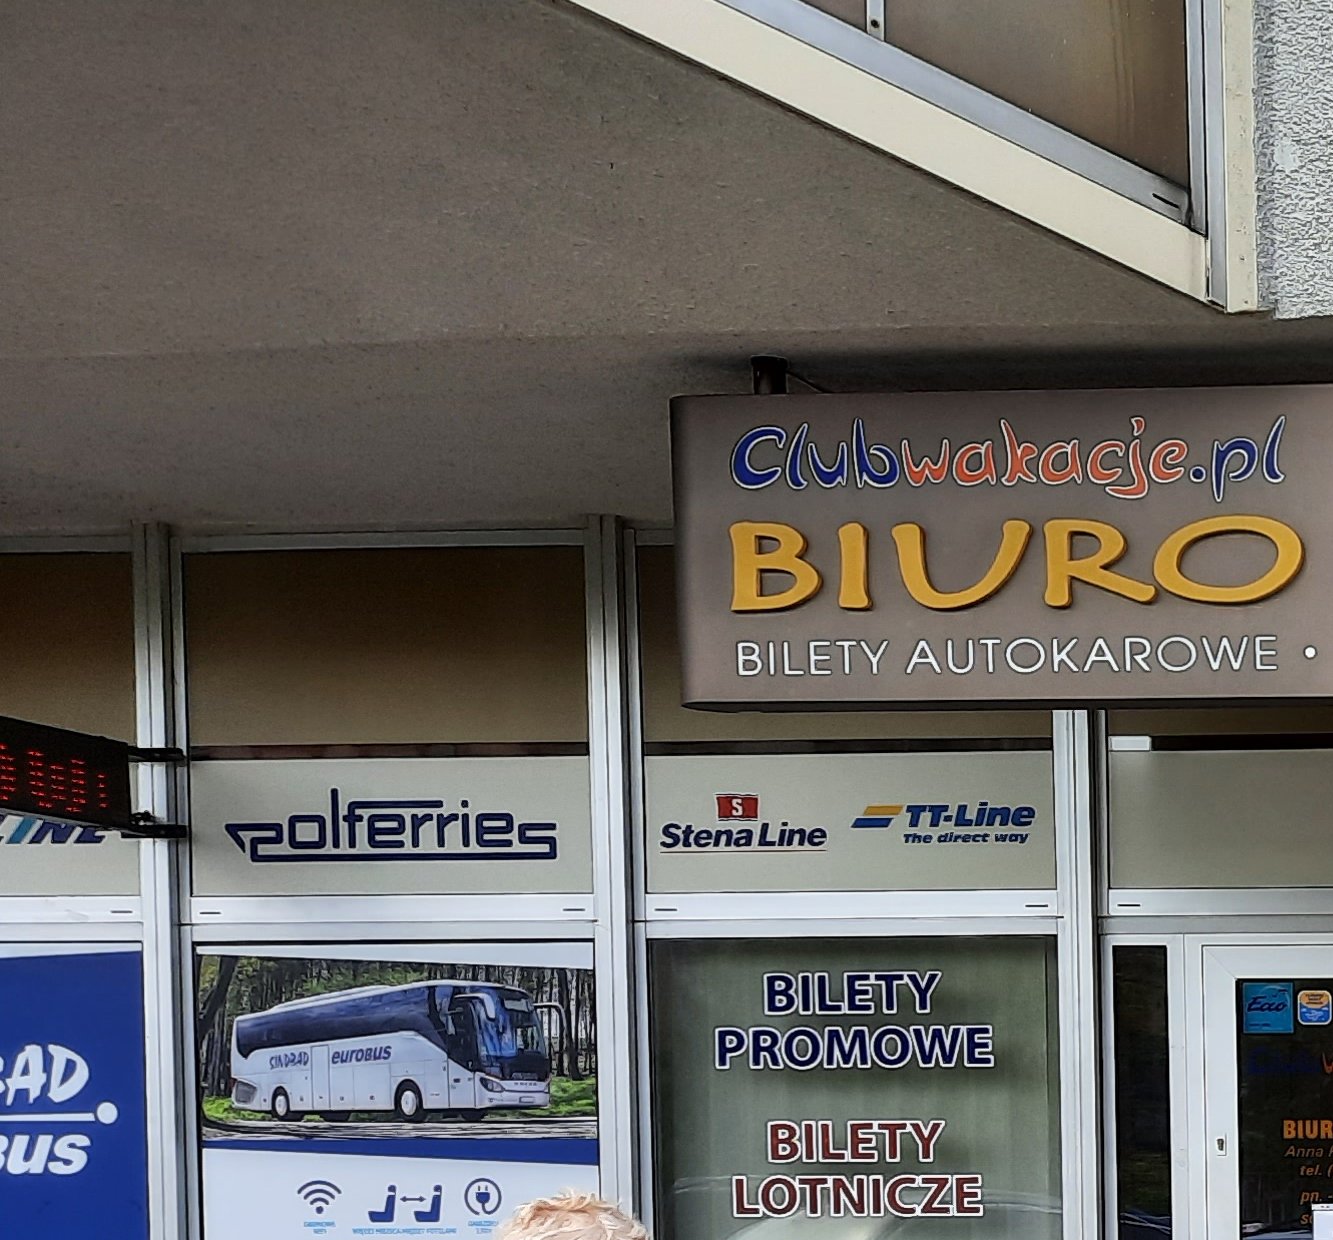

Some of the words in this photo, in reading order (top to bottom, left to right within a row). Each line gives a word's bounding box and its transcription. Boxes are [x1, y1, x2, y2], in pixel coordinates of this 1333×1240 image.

[730, 415, 1287, 501] Clubwakacje.pl
[729, 513, 1305, 612] BIURO
[736, 637, 890, 677] BILETY
[906, 634, 1278, 675] AUTOKAROWE
[660, 823, 752, 848] Stena
[758, 822, 828, 847] Line
[904, 802, 1036, 828] TT-Line
[904, 833, 933, 844] The
[937, 832, 989, 844] direct
[994, 832, 1030, 845] way
[763, 971, 942, 1015] BILETY
[715, 1025, 995, 1070] PROMOWE
[0, 1044, 90, 1106] AD
[767, 1120, 945, 1163] BILETY
[1284, 1145, 1324, 1158] Anna
[1300, 1164, 1322, 1176] tel.
[732, 1175, 983, 1218] LOTNICZE
[1300, 1191, 1322, 1205] pn.
